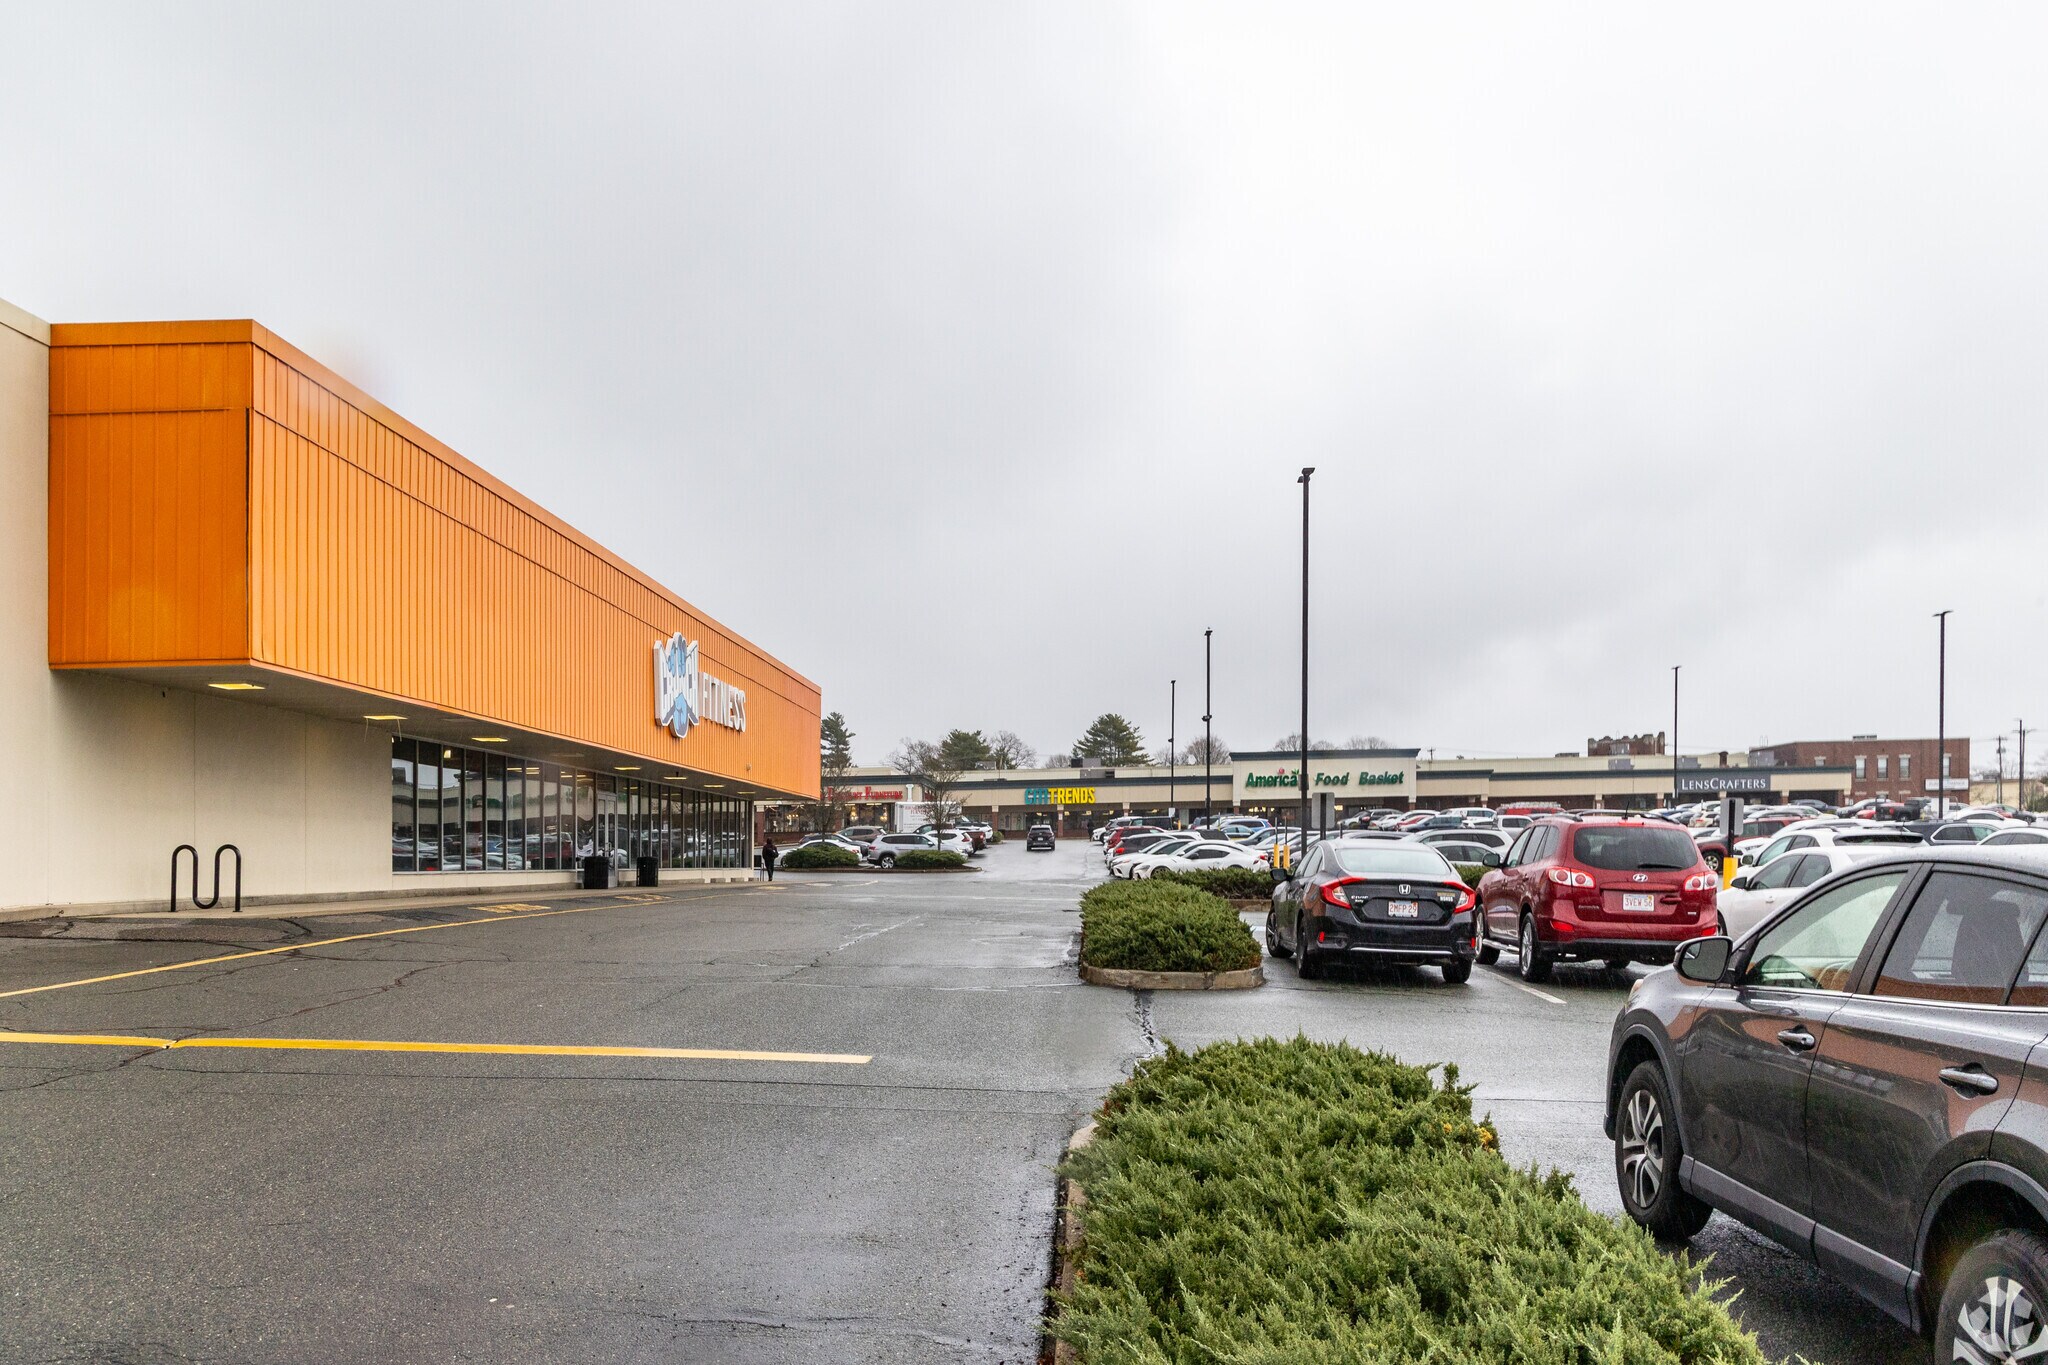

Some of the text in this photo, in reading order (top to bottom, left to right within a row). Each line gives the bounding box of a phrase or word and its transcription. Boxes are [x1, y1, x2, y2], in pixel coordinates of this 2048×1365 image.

[653, 640, 746, 733] CRUNCH FITNESS
[1246, 768, 1404, 787] America Food Basket
